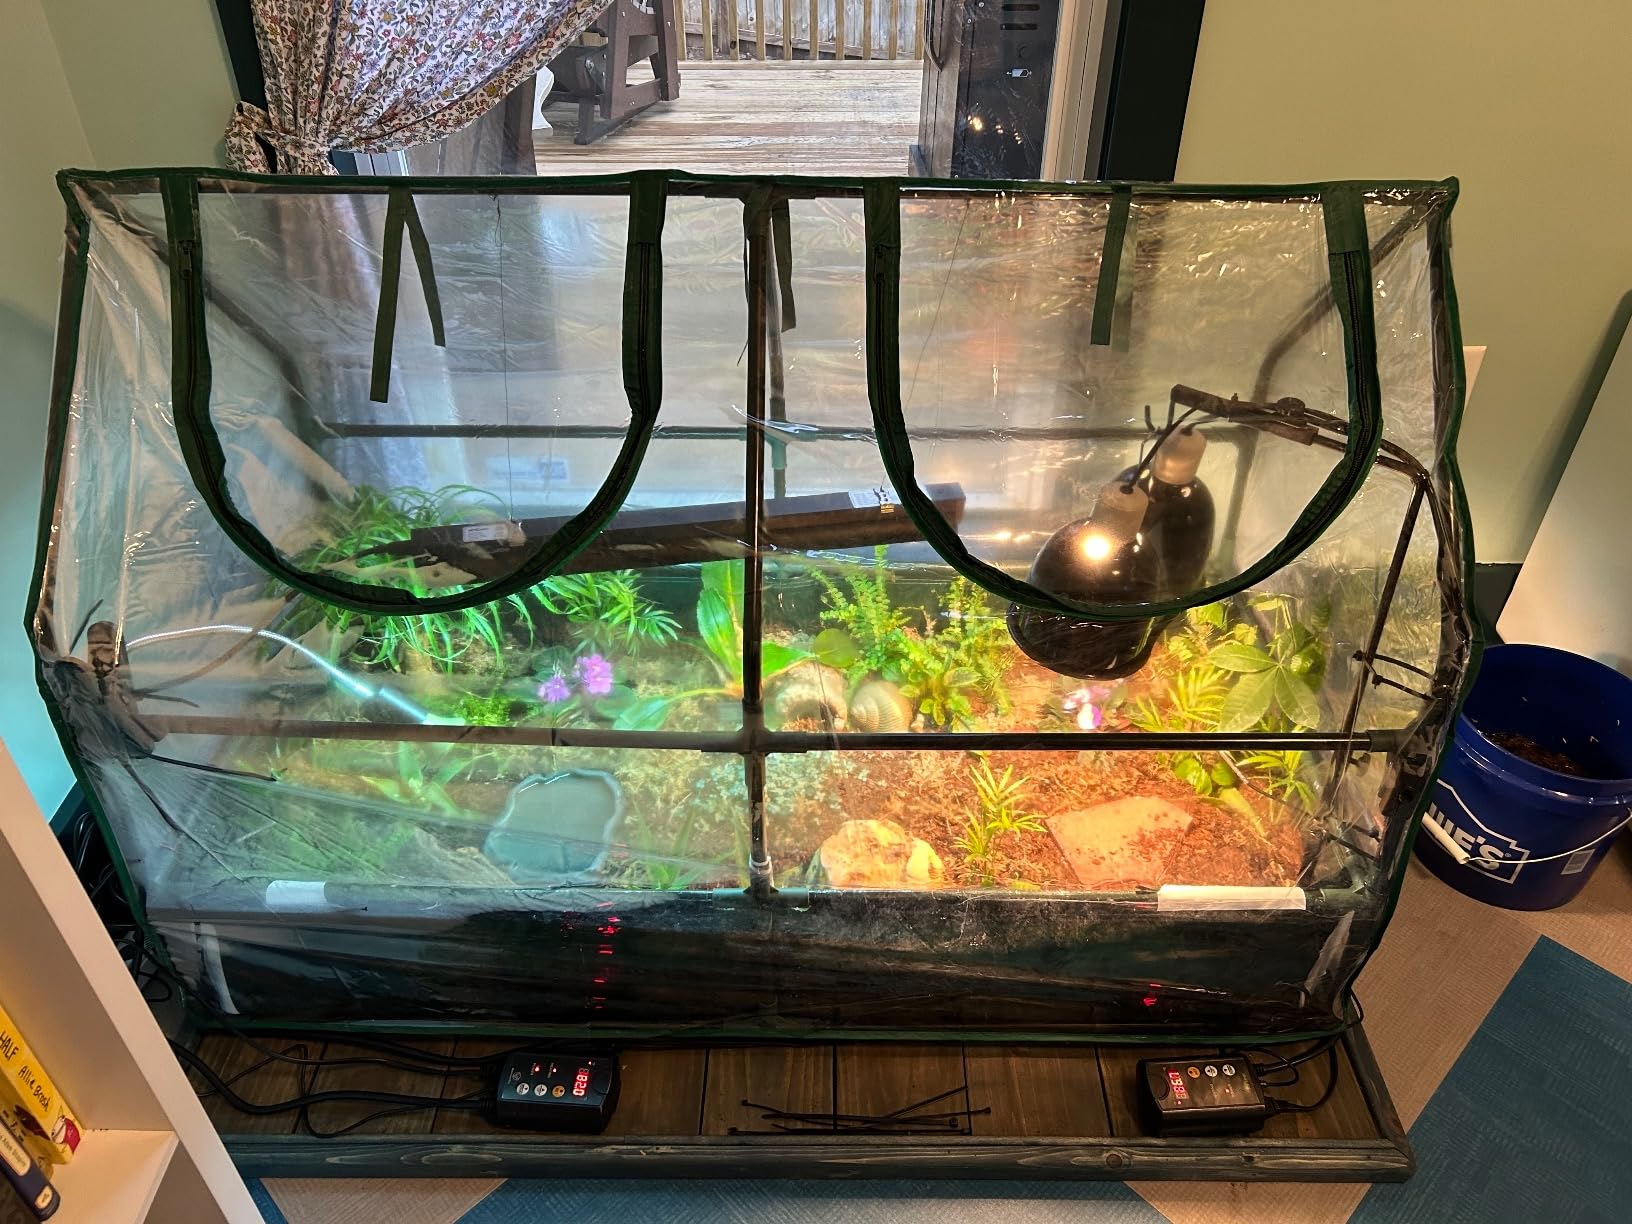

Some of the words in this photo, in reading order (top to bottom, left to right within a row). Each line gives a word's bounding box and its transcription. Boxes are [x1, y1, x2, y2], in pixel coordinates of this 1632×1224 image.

[0, 1030, 19, 1061] HALF
[18, 1065, 35, 1089] Allie
[33, 1085, 50, 1112] Brosh
